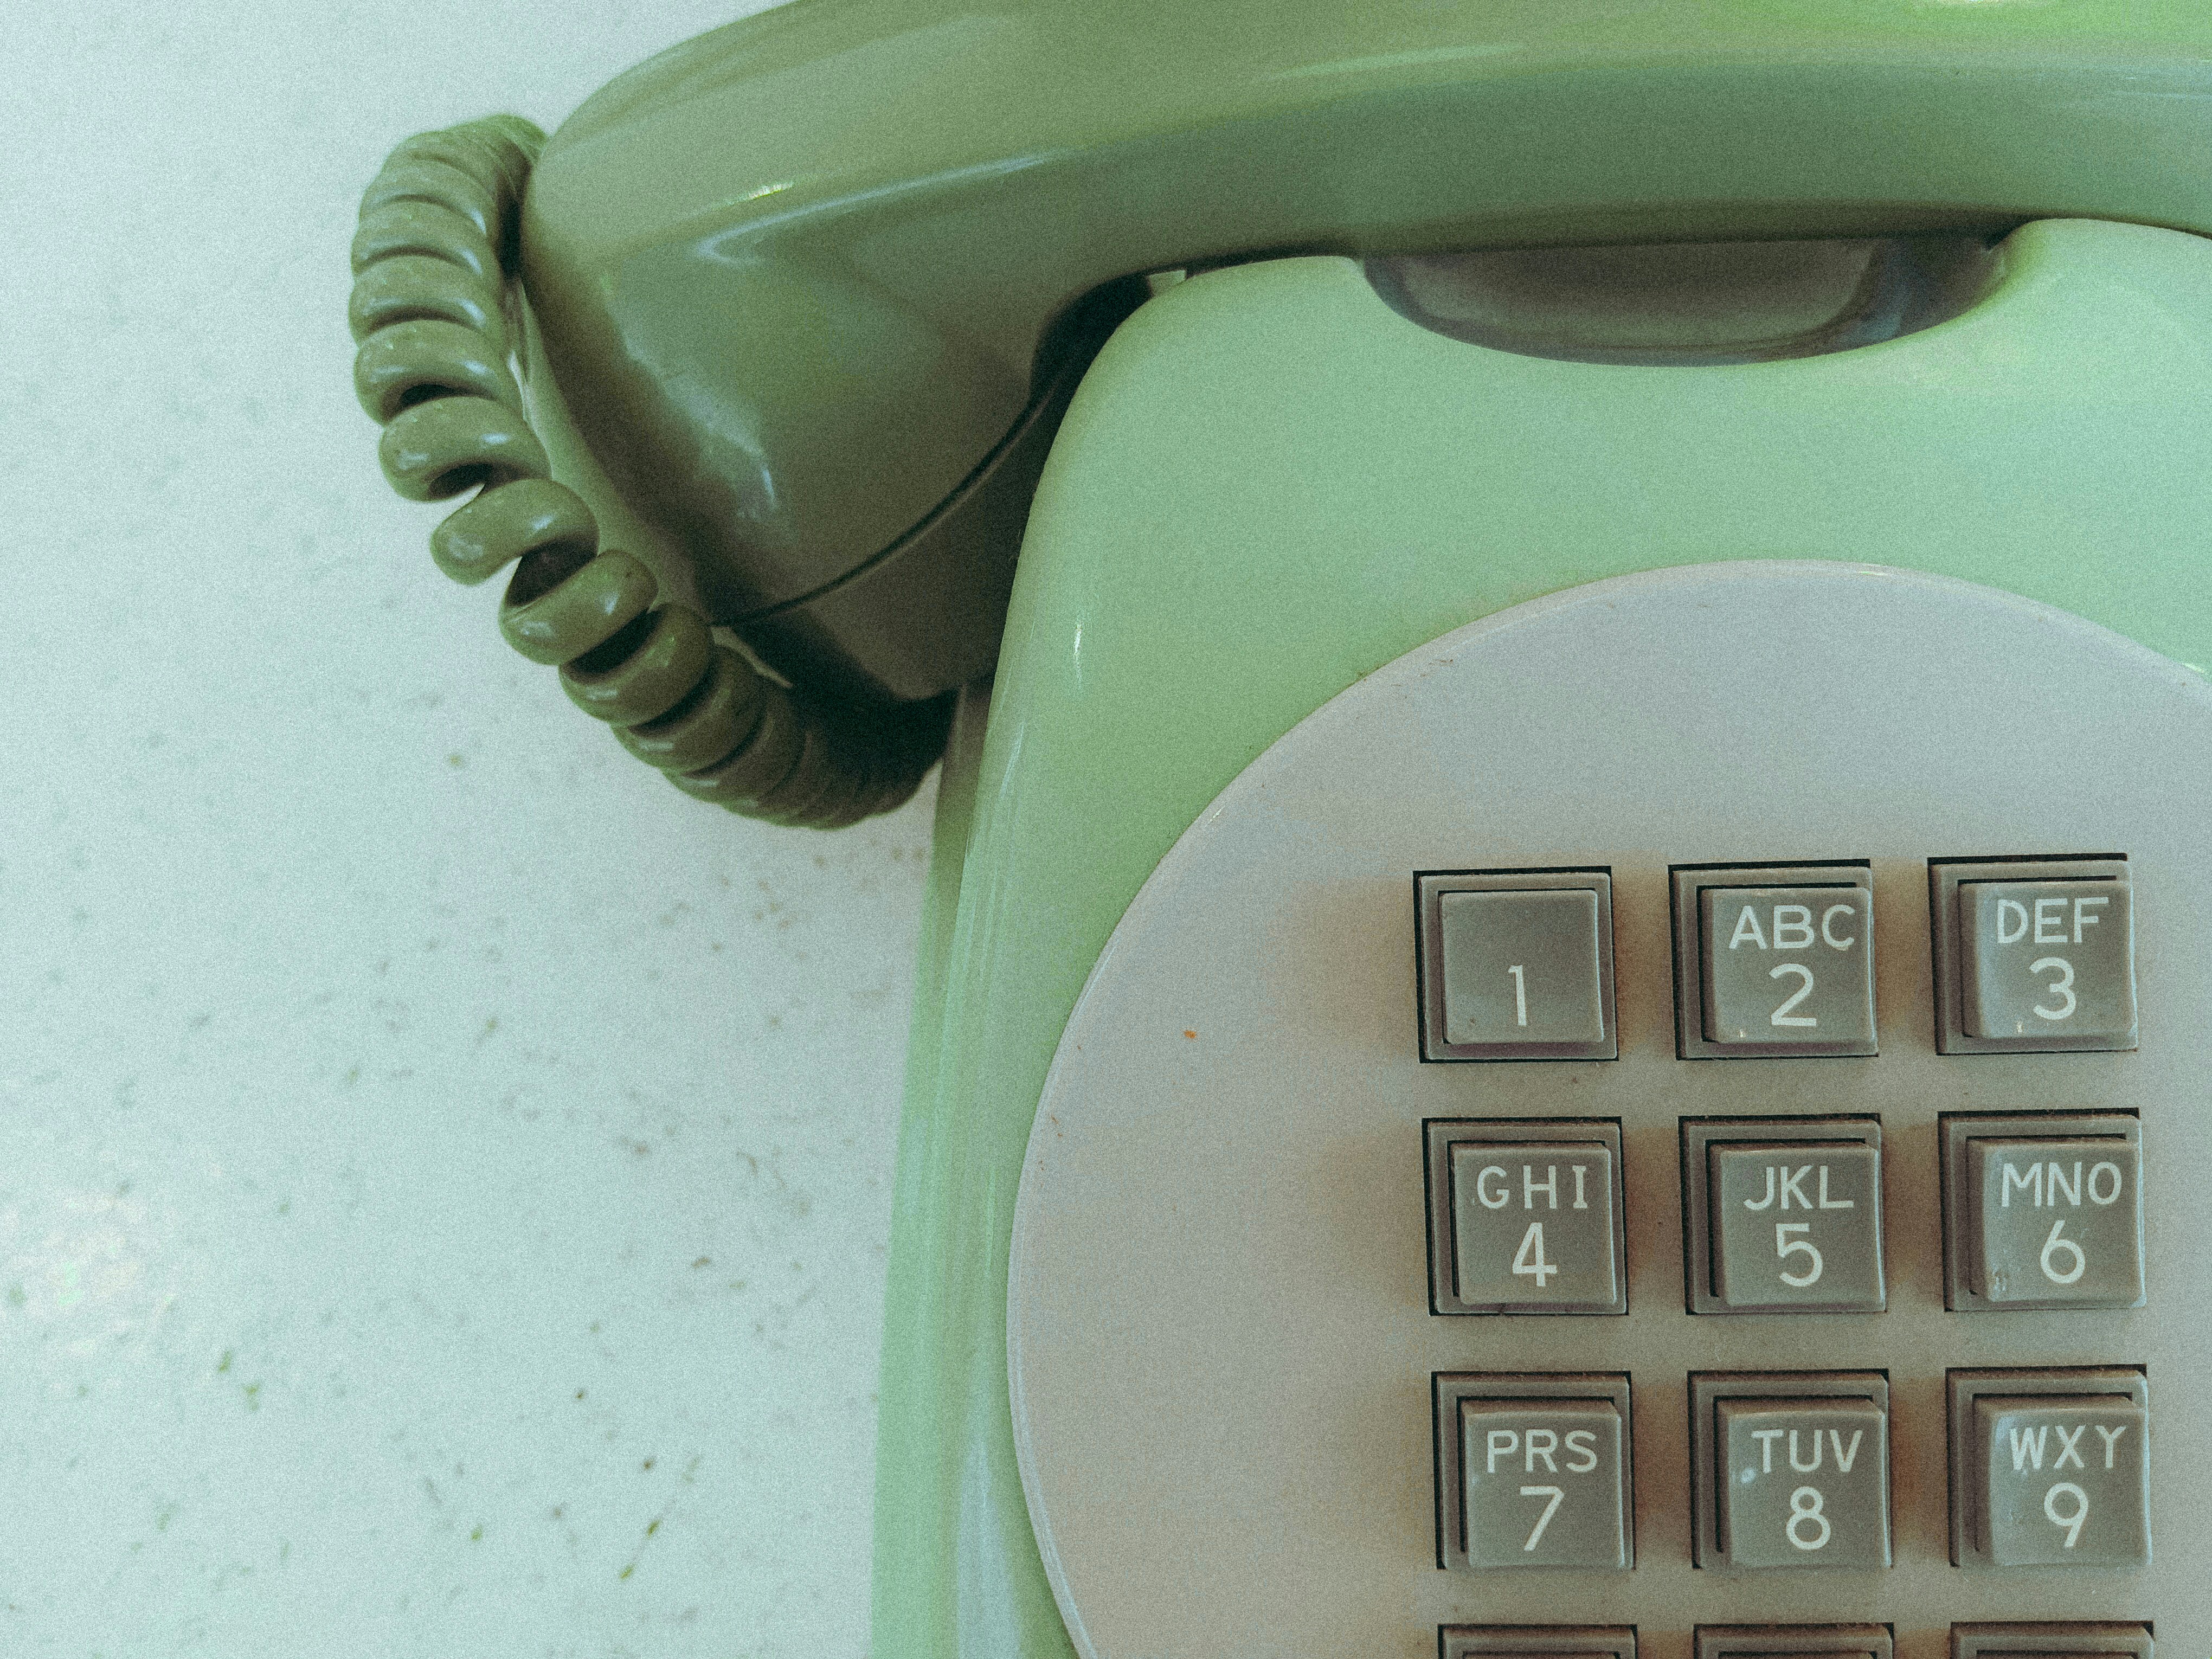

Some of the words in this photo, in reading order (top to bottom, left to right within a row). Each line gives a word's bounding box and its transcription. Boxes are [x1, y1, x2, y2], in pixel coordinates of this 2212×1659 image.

[1729, 905, 1855, 951] ABC
[1996, 898, 2109, 944] DEF
[1509, 966, 1527, 1026] 1
[1770, 964, 1817, 1026] 2
[2030, 957, 2076, 1020] 3
[1477, 1166, 1587, 1209] GHI
[1744, 1166, 1853, 1211] JKL
[2002, 1162, 2122, 1207] MNO
[1512, 1223, 1557, 1287] 4
[1776, 1224, 1823, 1287] 5
[2040, 1220, 2085, 1284] 6
[1487, 1430, 1597, 1474] PRS
[1752, 1430, 1861, 1474] TUV
[2009, 1426, 2123, 1471] WXY
[1520, 1486, 1564, 1551] 7
[1786, 1487, 1830, 1550] 8
[2044, 1483, 2088, 1547] 9
